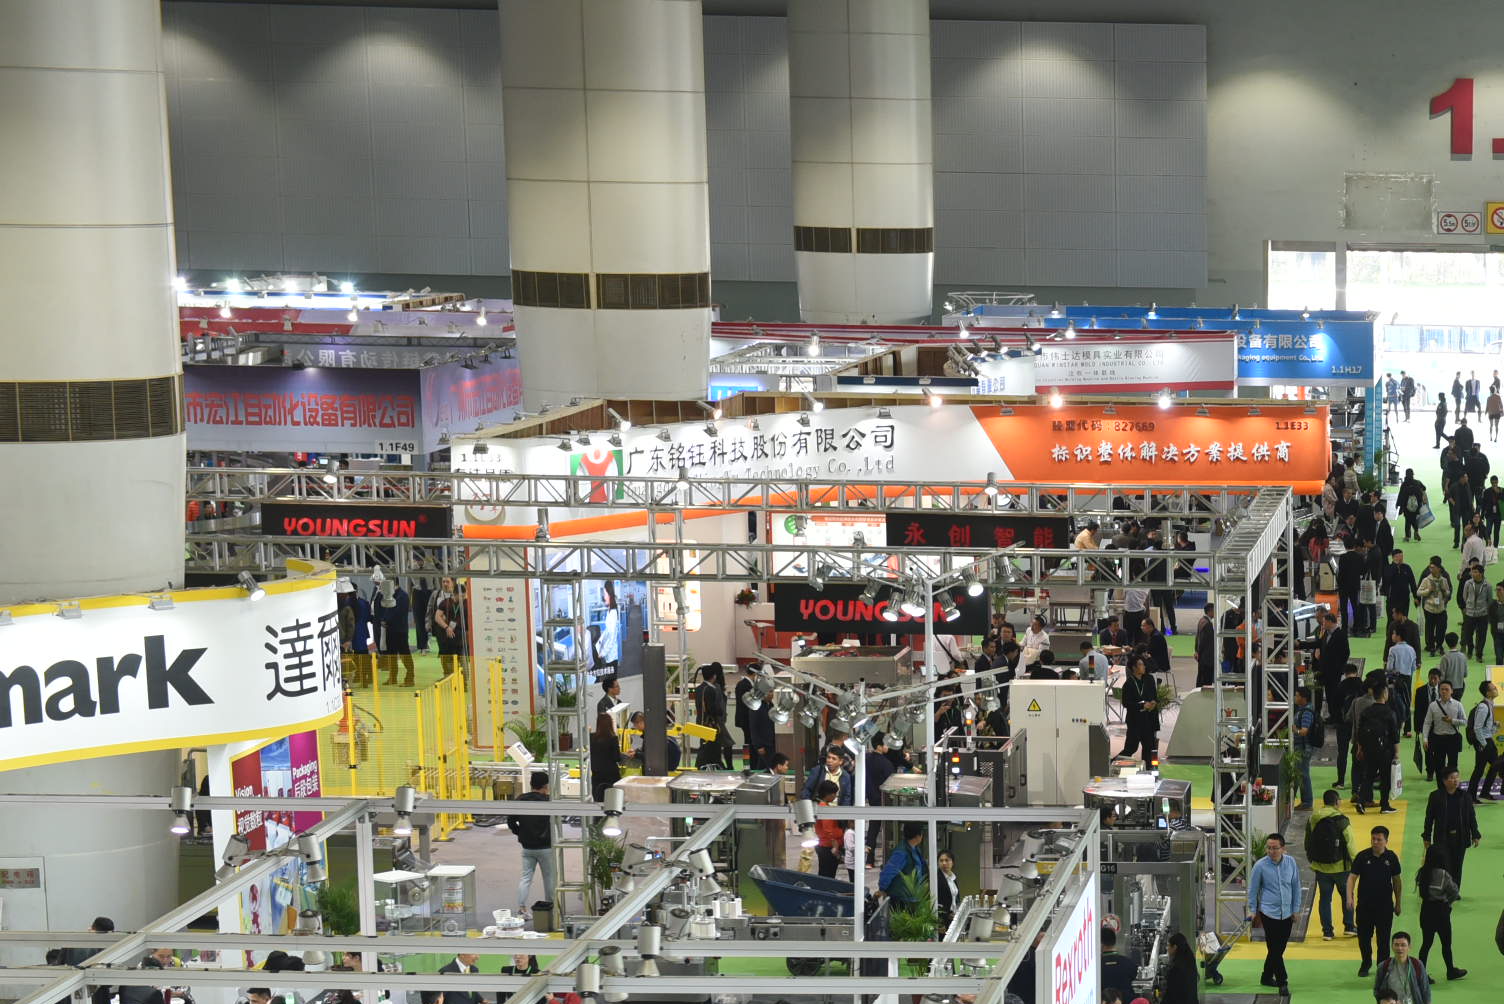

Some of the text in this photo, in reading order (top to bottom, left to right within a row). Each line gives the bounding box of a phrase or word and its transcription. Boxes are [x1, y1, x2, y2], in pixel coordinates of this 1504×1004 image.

[378, 441, 415, 453] 1.1F49
[1051, 439, 1292, 465] 标识整体解决方案提供商
[283, 516, 417, 538] YOUNGSUN
[292, 760, 318, 780] Packaging
